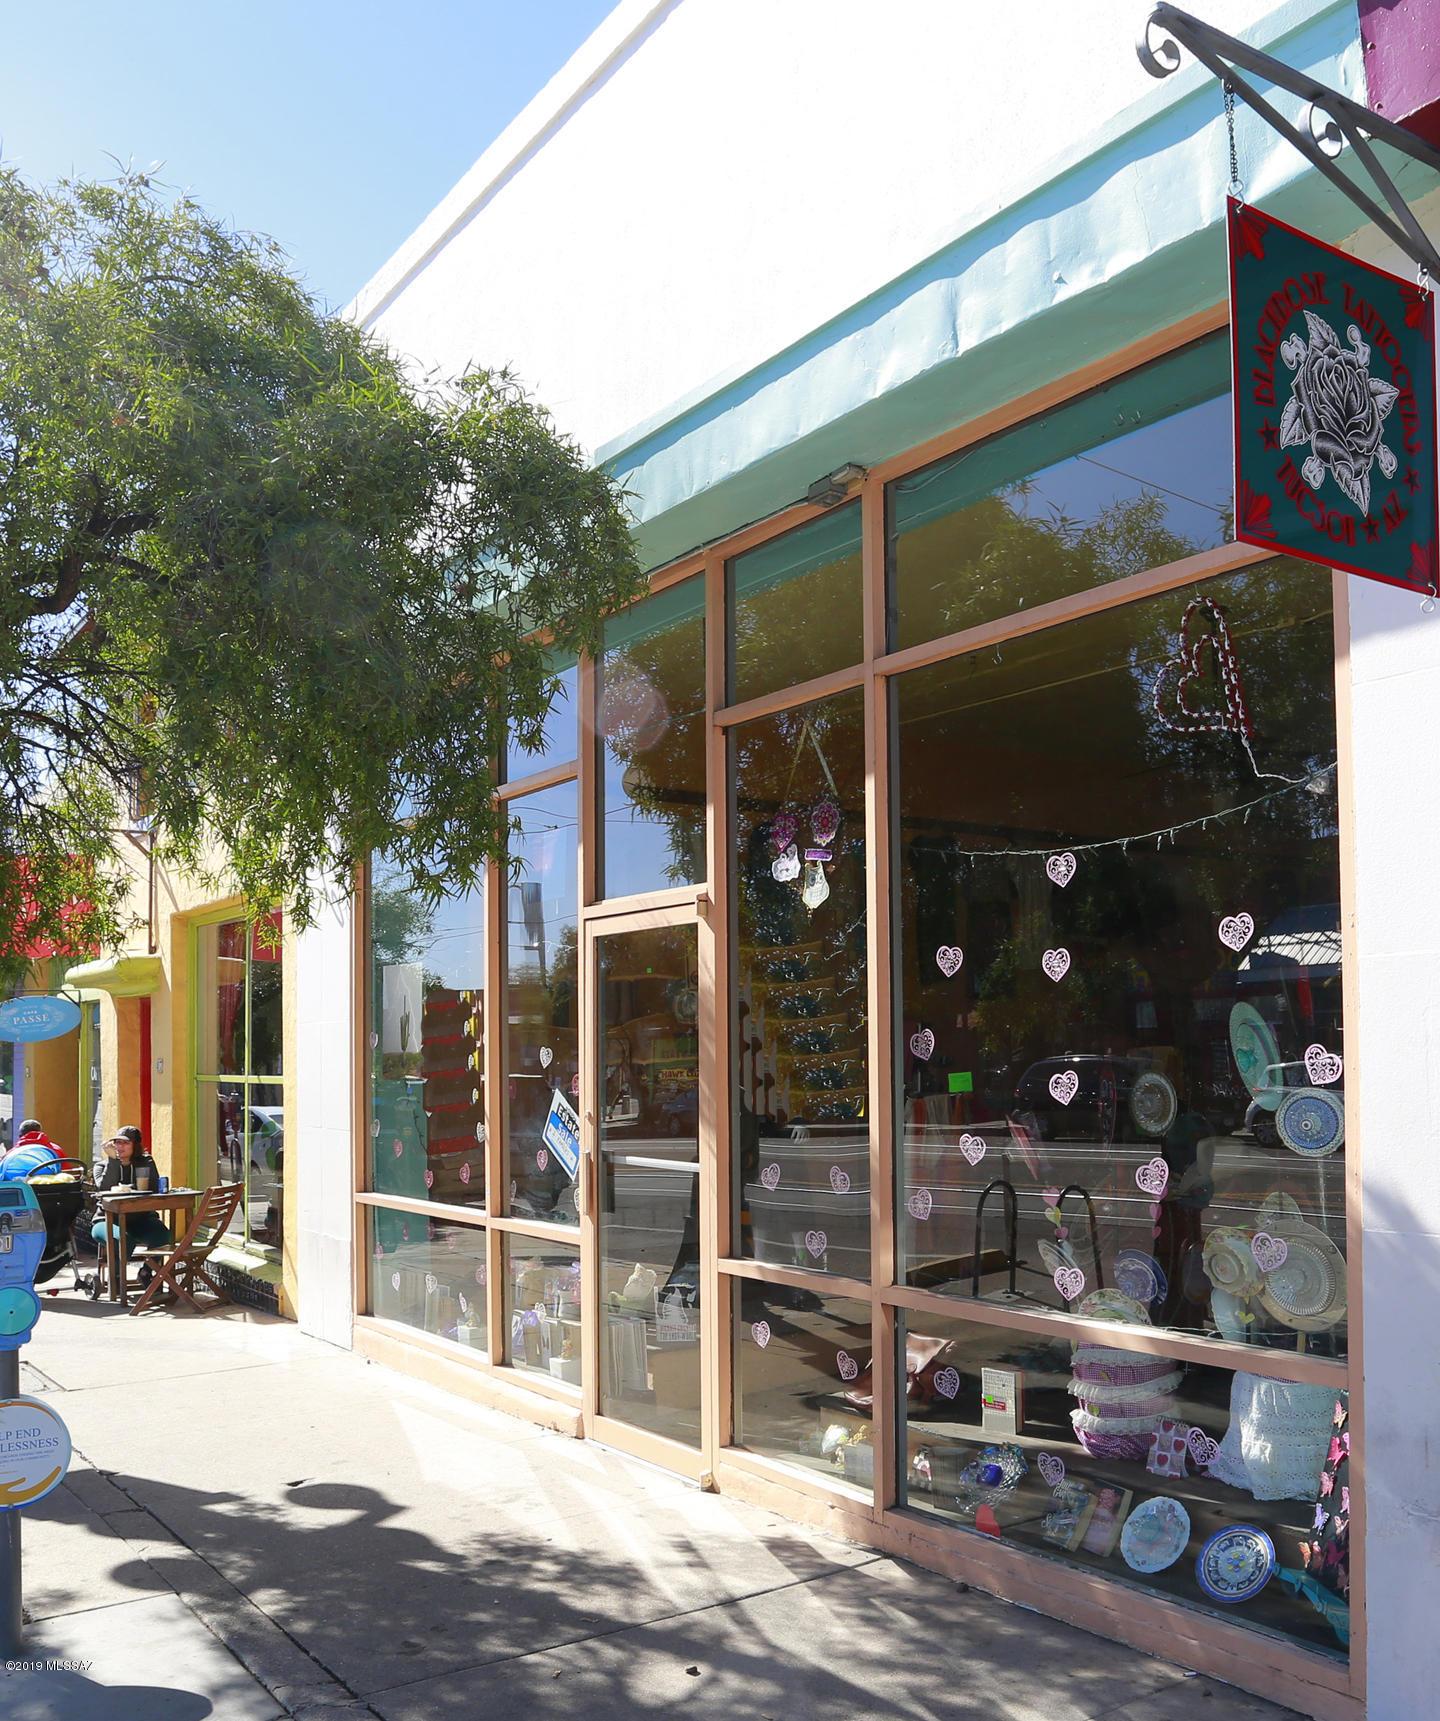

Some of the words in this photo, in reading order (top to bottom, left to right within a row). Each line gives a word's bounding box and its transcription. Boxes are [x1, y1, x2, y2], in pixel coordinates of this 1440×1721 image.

[1380, 490, 1408, 535] AZ
[557, 1105, 579, 1140] Estate
[558, 1123, 572, 1145] Sale
[15, 1427, 41, 1439] END
[0, 1437, 59, 1452] LESSNESS
